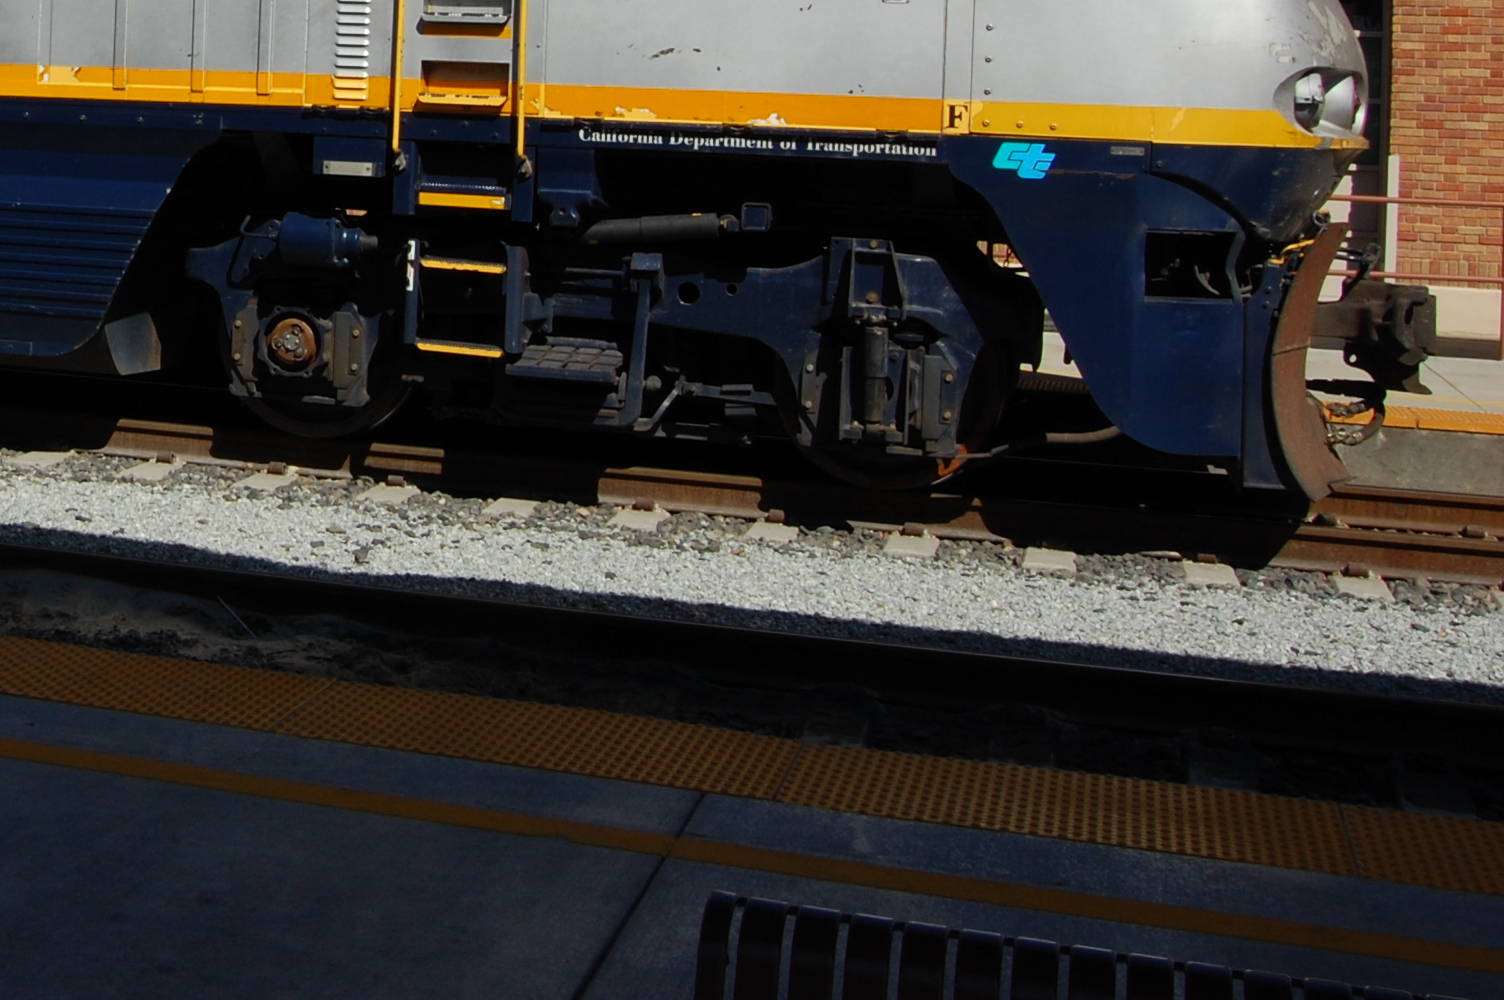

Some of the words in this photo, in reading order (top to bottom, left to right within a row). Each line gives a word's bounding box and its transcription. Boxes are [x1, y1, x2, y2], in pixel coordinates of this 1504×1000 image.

[946, 104, 969, 129] F
[578, 126, 663, 145] California
[669, 131, 773, 150] Department
[806, 136, 937, 157] Transportation
